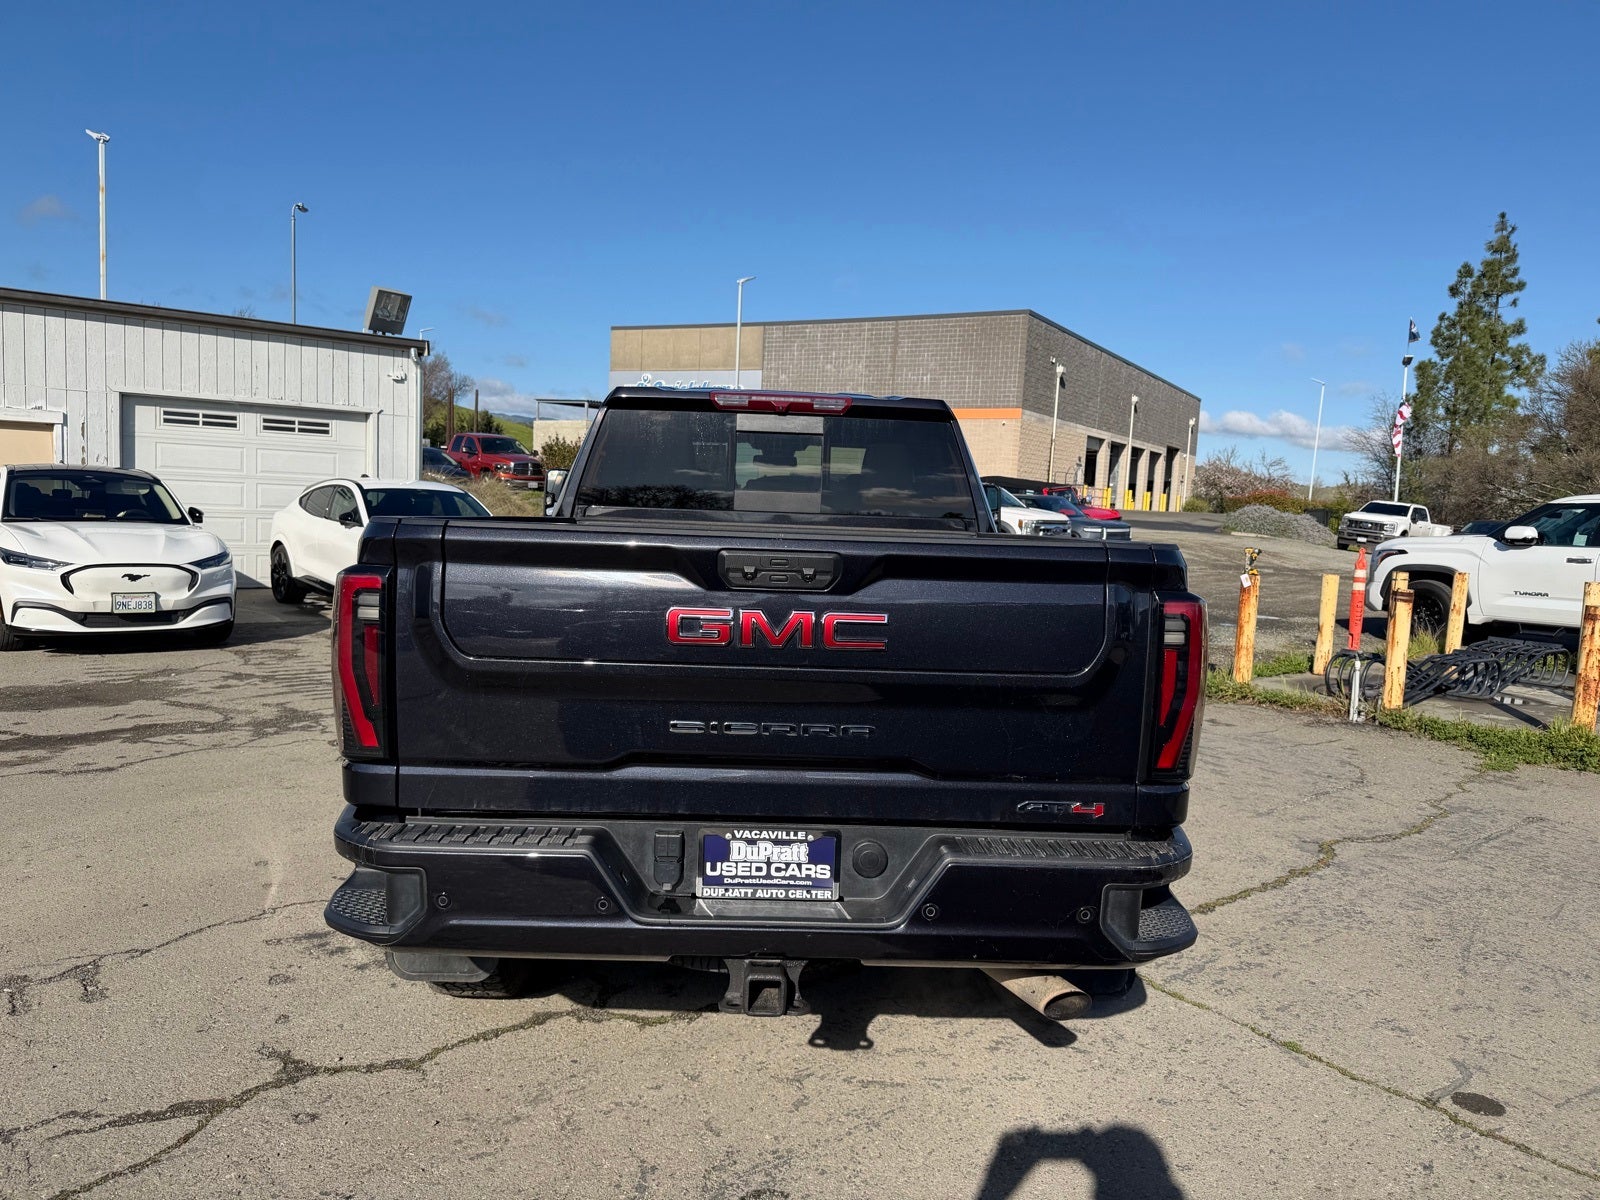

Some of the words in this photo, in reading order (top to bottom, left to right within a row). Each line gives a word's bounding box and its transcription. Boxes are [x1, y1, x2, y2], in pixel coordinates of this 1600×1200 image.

[1513, 590, 1550, 598] TUNDRA
[116, 600, 153, 610] 9NEJ838
[666, 607, 888, 650] GMC
[669, 719, 876, 738] SIERRA
[1016, 800, 1105, 819] AT4
[733, 829, 806, 840] VACAVILLE
[730, 840, 809, 863] DuPratt
[706, 861, 767, 876] USED
[770, 863, 831, 879] CARS
[723, 877, 812, 886] DuPrattUsedCars.com
[703, 887, 753, 898] DUPRATT
[755, 888, 786, 898] AUTO
[788, 889, 832, 899] CENTER
